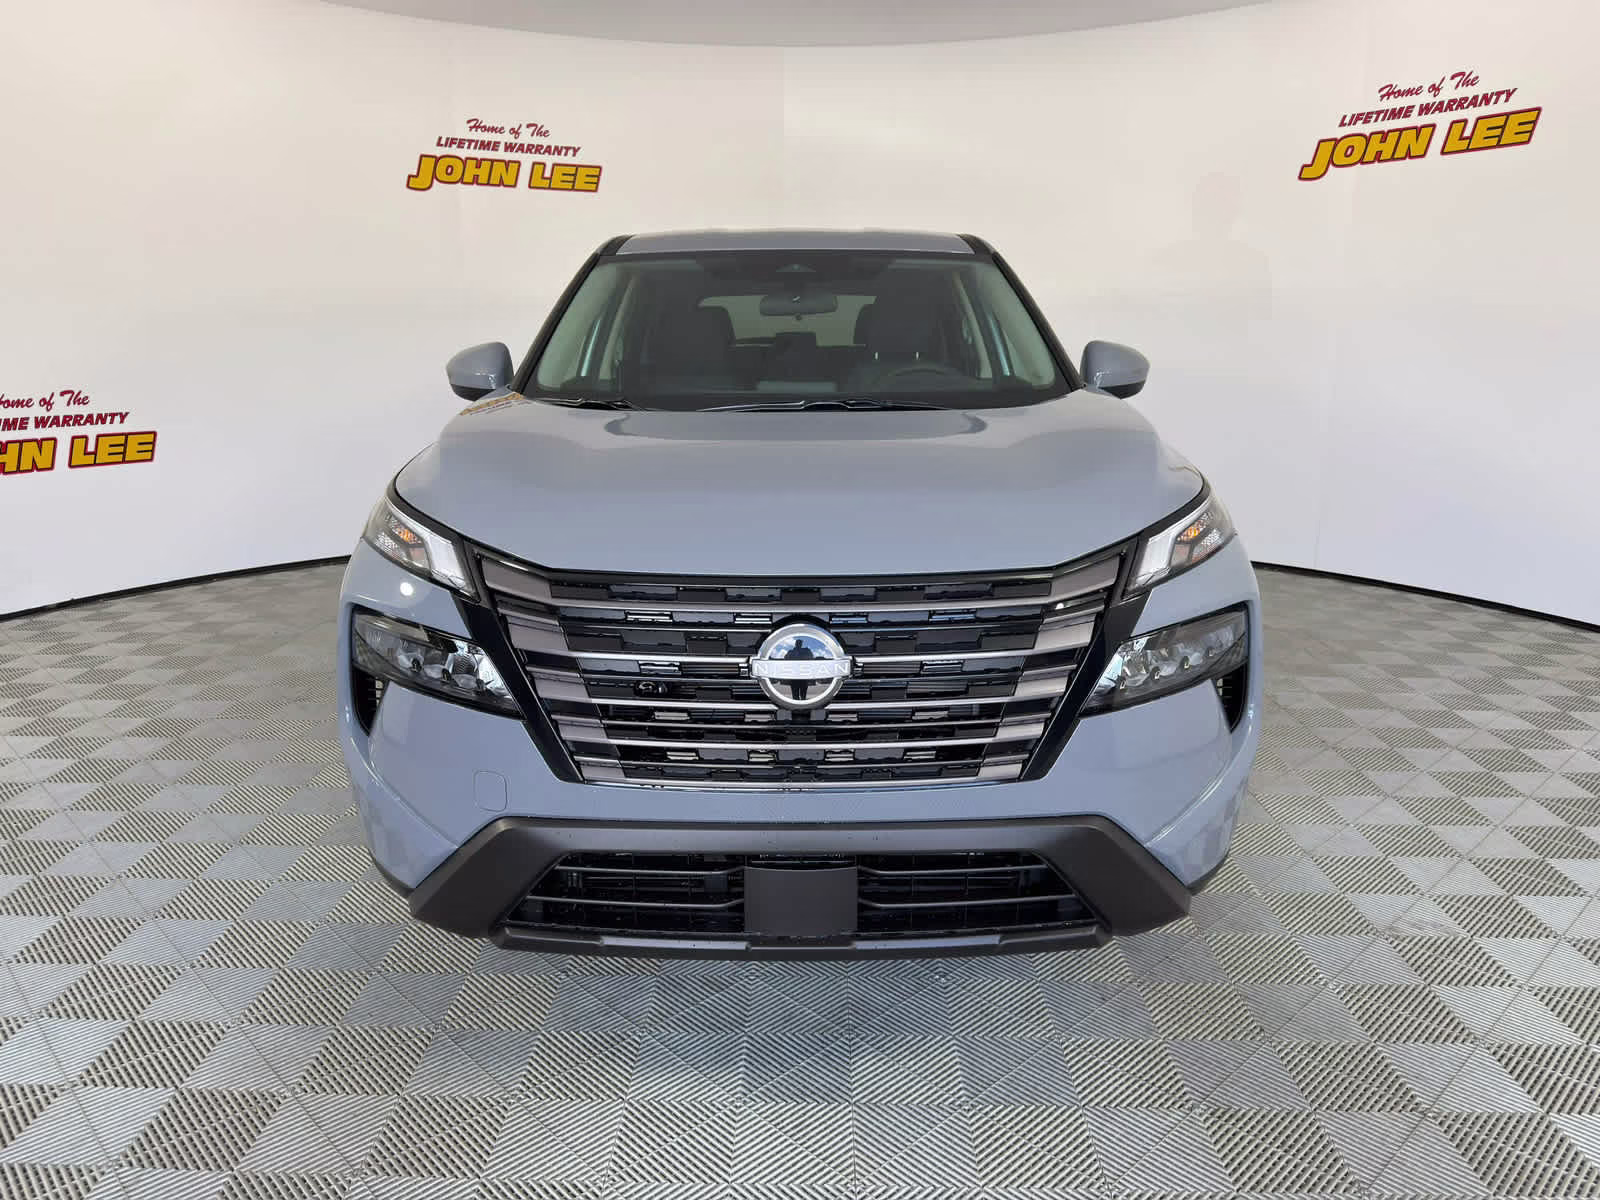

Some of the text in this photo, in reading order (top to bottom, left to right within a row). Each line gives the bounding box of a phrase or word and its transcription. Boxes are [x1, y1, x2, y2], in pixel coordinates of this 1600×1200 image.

[1378, 70, 1479, 102] Home of The
[1338, 88, 1518, 127] LIFETIME WARRANTY
[466, 118, 550, 139] Home of The
[1298, 107, 1542, 181] JOHN LEE
[436, 136, 581, 157] LIFETIME WARRANTY
[407, 154, 602, 193] JOHN LEE
[39, 392, 54, 412] of
[60, 390, 90, 406] The
[34, 412, 129, 429] WARRANTY
[68, 431, 157, 468] LEE
